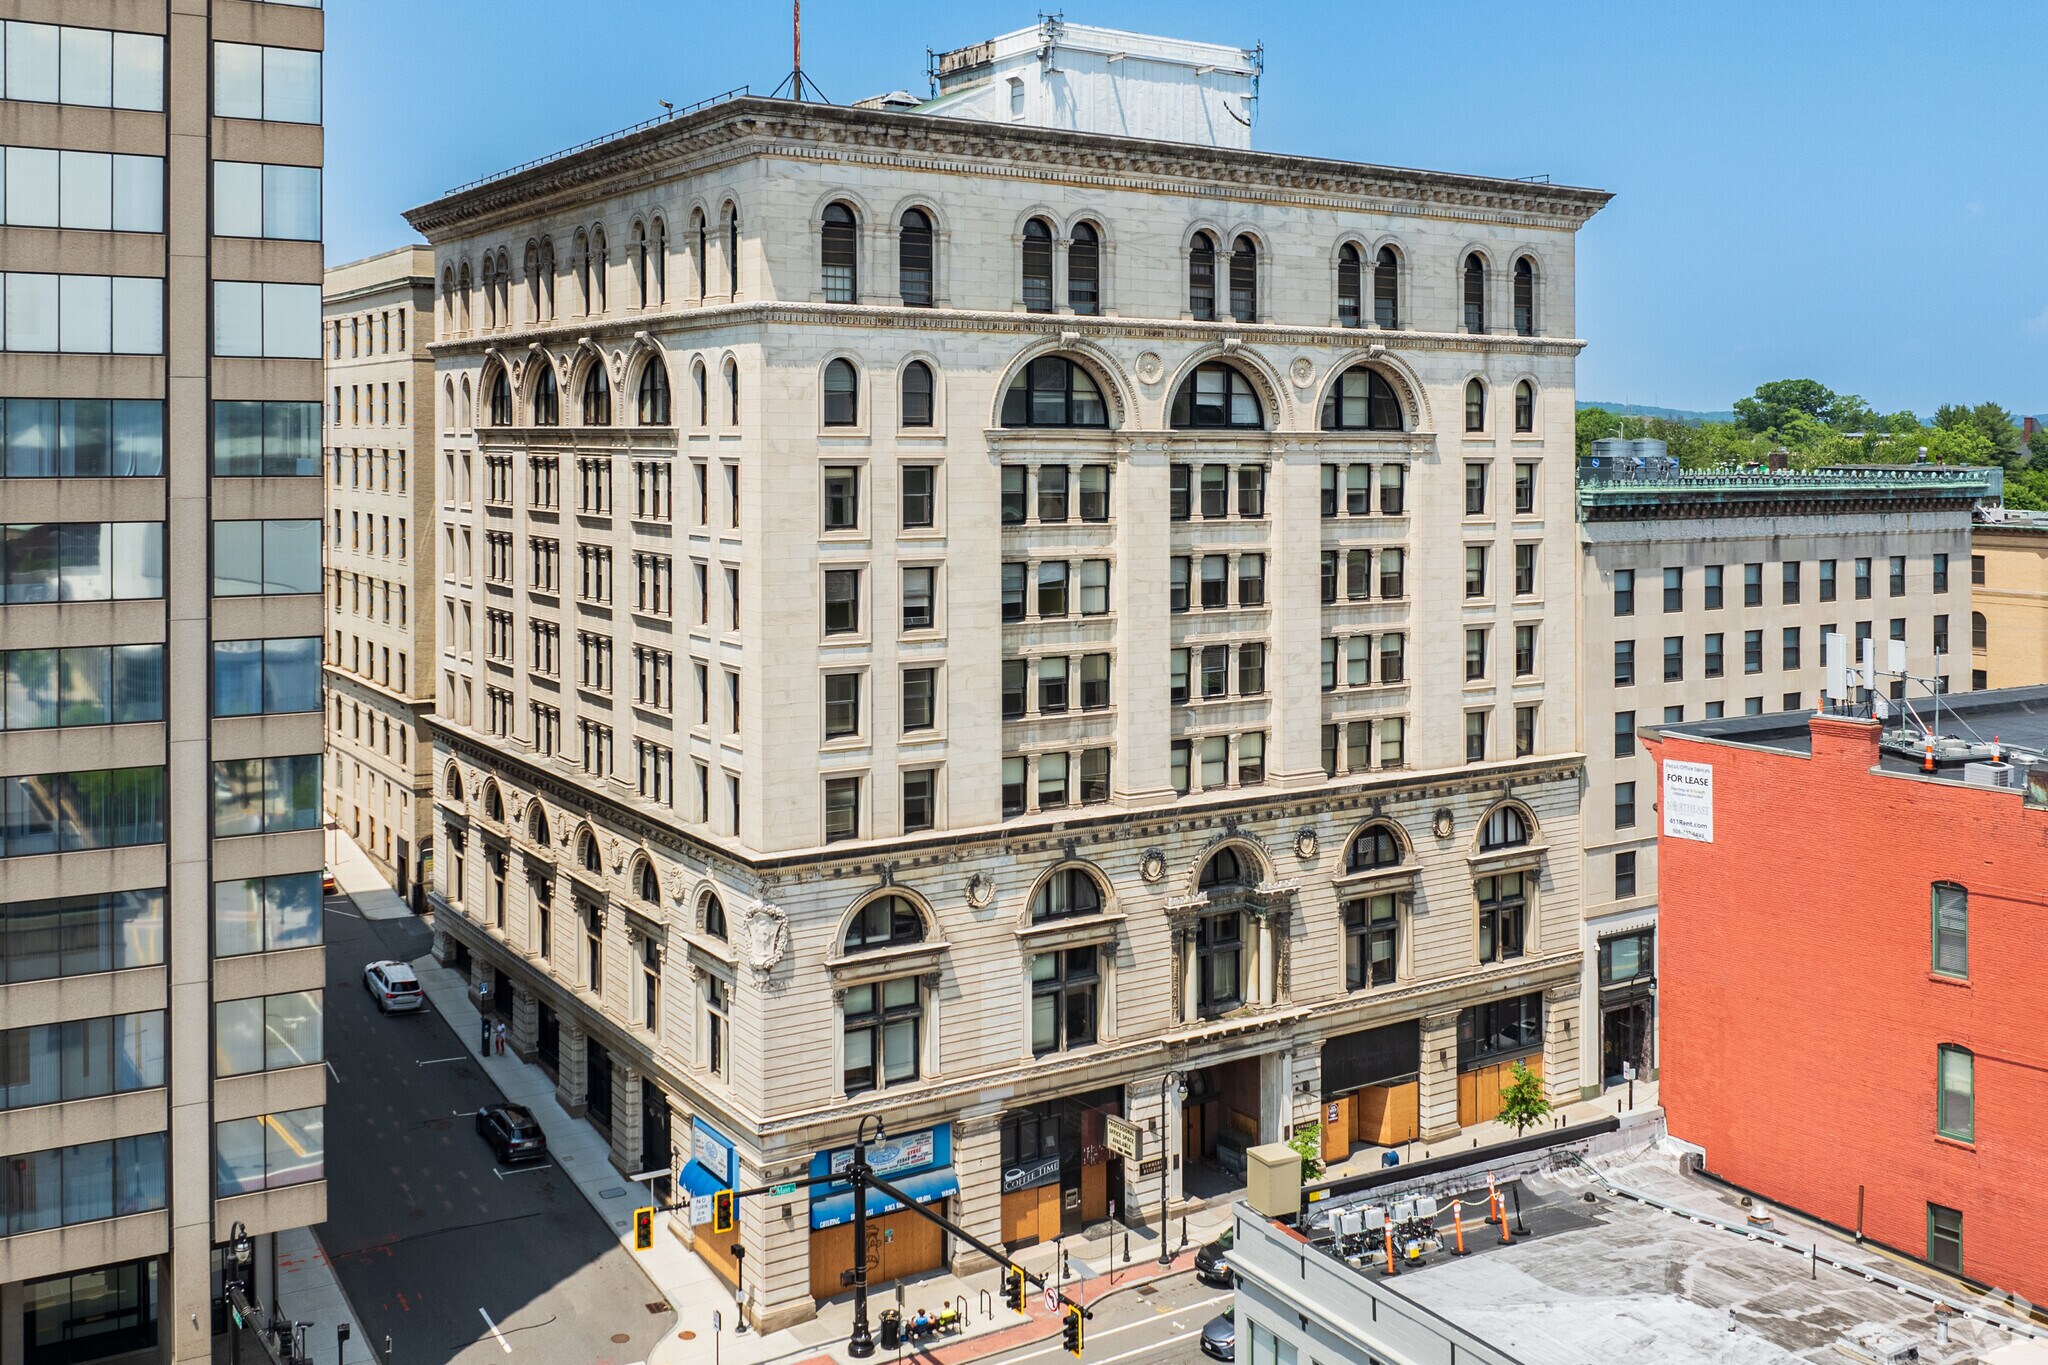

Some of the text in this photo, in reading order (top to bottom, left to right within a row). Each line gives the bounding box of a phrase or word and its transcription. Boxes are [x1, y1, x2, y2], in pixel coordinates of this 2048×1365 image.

[1667, 773, 1709, 786] FOR LEASE
[1669, 818, 1708, 829] 411Rent.com
[1108, 1120, 1135, 1137] PROFESSIONAL
[1109, 1128, 1134, 1144] OFFICE SPACE
[1112, 1137, 1131, 1150] AVAILABLE
[1142, 1160, 1162, 1169] COMMERC
[1005, 1162, 1059, 1190] COFFEE TIME
[820, 1217, 840, 1228] CATERING
